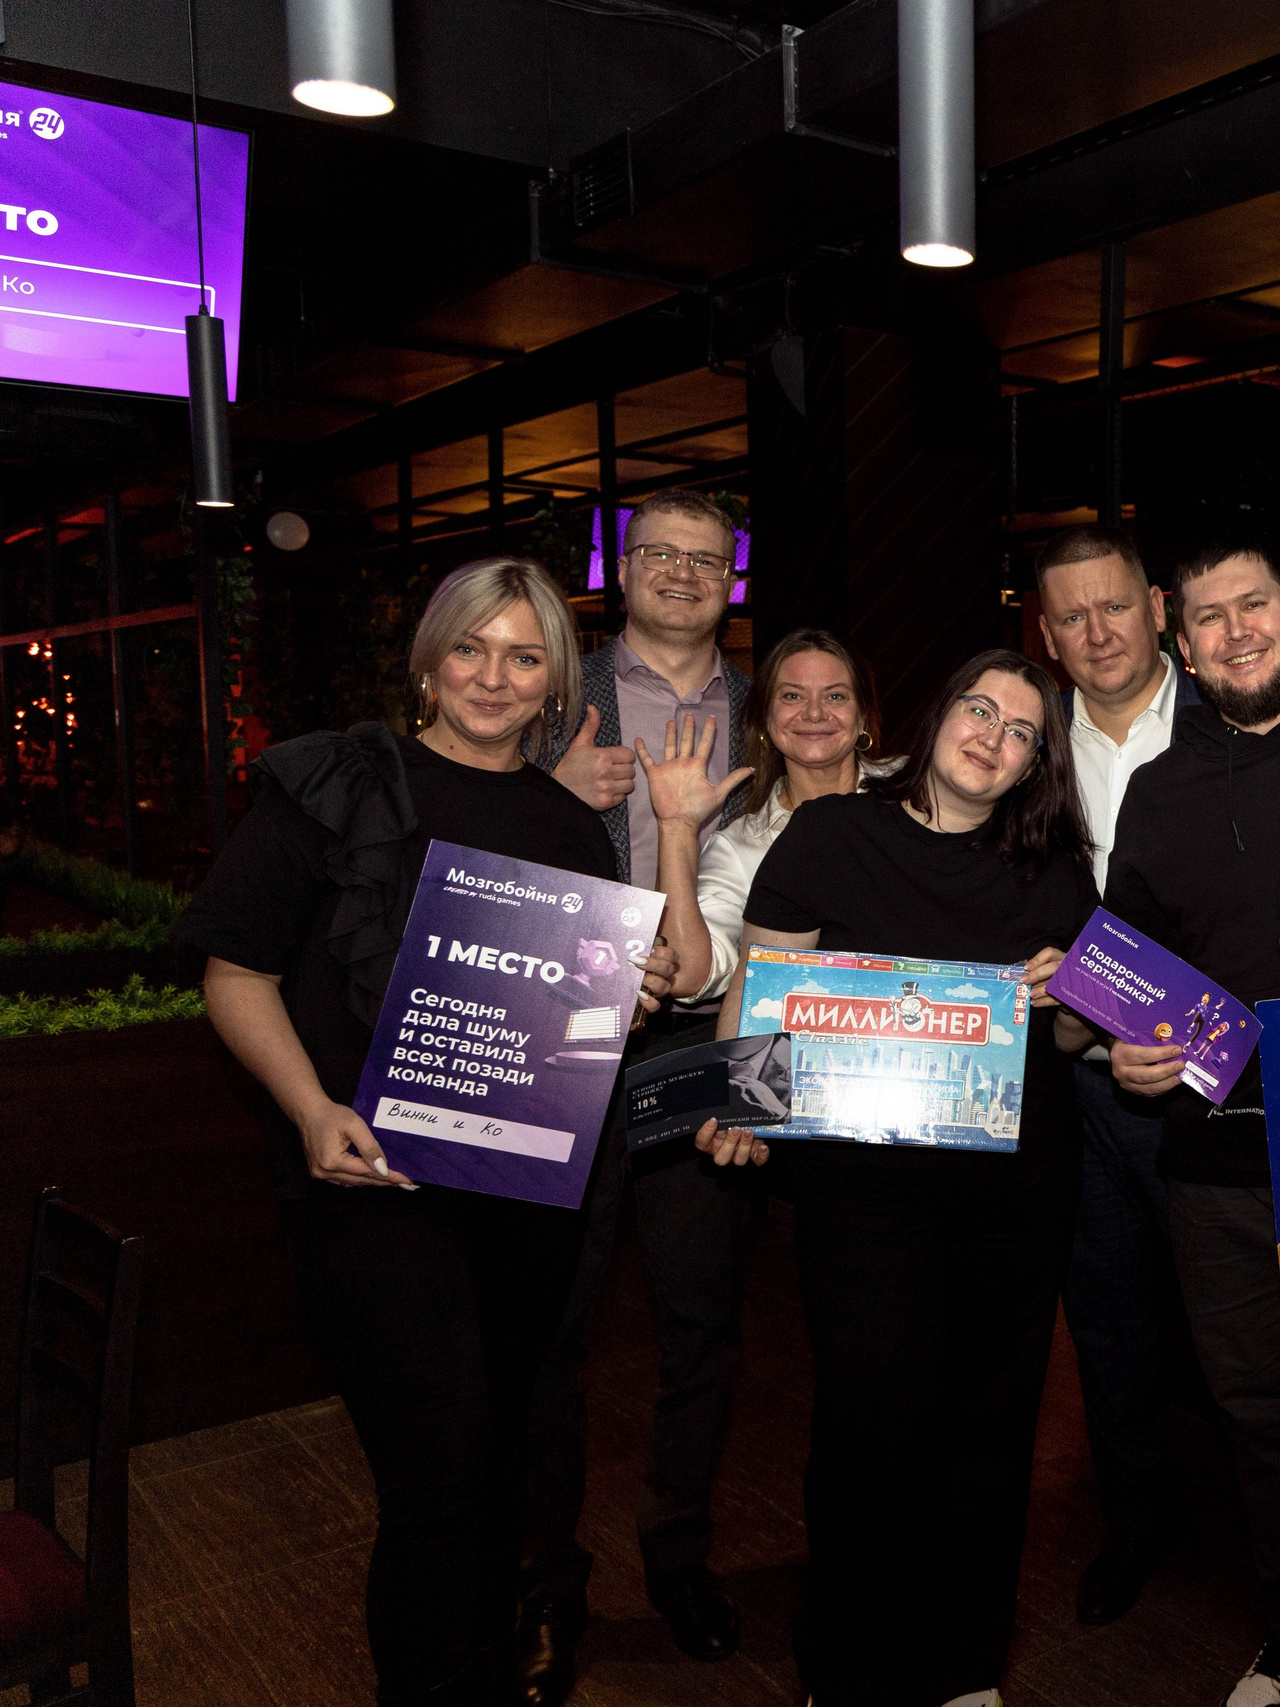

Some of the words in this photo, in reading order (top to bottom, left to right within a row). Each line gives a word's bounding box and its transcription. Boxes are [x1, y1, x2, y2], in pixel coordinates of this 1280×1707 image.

[31, 110, 62, 136] 24
[446, 867, 558, 905] Мозгобойня
[561, 894, 583, 912] 24
[496, 896, 521, 907] games
[1102, 922, 1139, 949] Мозгобойня
[427, 935, 441, 958] 1
[448, 940, 565, 984] МЕСТО
[1086, 943, 1166, 1001] Подарочный
[1080, 955, 1155, 1007] сертификат
[410, 988, 507, 1021] Сегодня
[790, 1002, 983, 1035] МИЛЛИОНЕР
[402, 1009, 460, 1031] дала
[465, 1021, 531, 1048] шуму
[795, 1030, 870, 1047] Classic
[399, 1028, 414, 1042] и
[420, 1032, 527, 1064] оставила
[387, 1065, 489, 1097] команда
[393, 1046, 448, 1069] всех
[452, 1058, 535, 1086] позади
[387, 1103, 438, 1124] Винни
[453, 1120, 465, 1129] и
[480, 1121, 503, 1136] Ко
[632, 1096, 658, 1110] -10%
[1224, 1107, 1266, 1115] INTERNATIO
